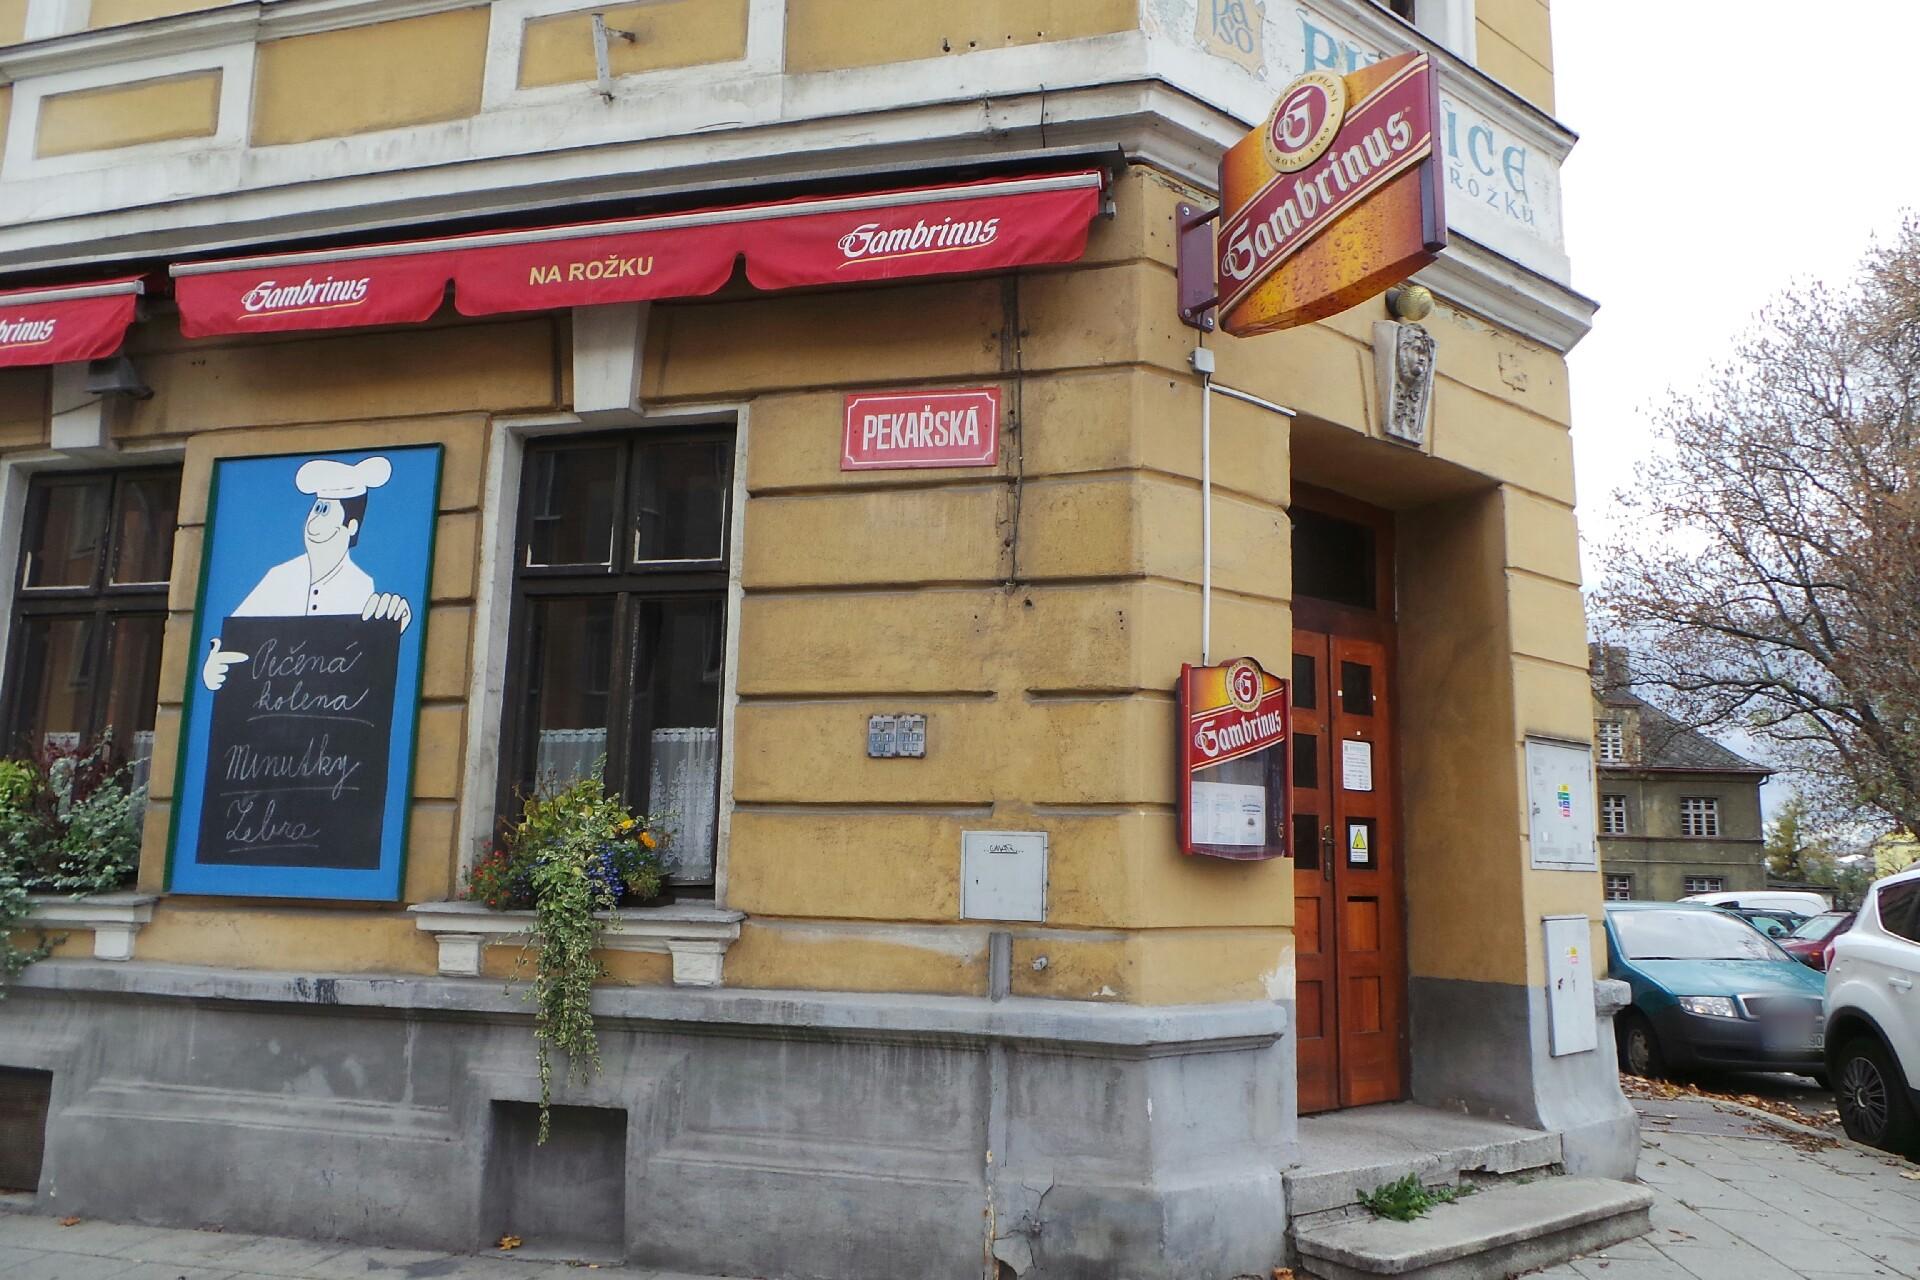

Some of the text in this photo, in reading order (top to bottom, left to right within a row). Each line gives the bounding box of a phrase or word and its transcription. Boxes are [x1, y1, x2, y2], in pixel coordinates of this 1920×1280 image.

[1221, 110, 1412, 281] Gambrinus
[837, 216, 1001, 258] Gambrinus
[529, 254, 654, 286] NA ROŽKU
[241, 276, 371, 312] Gambrinus
[0, 317, 57, 343] brinus
[862, 404, 980, 451] PEKAŘSKÁ
[252, 680, 370, 711] kolena
[1194, 709, 1282, 758] Gambrinus
